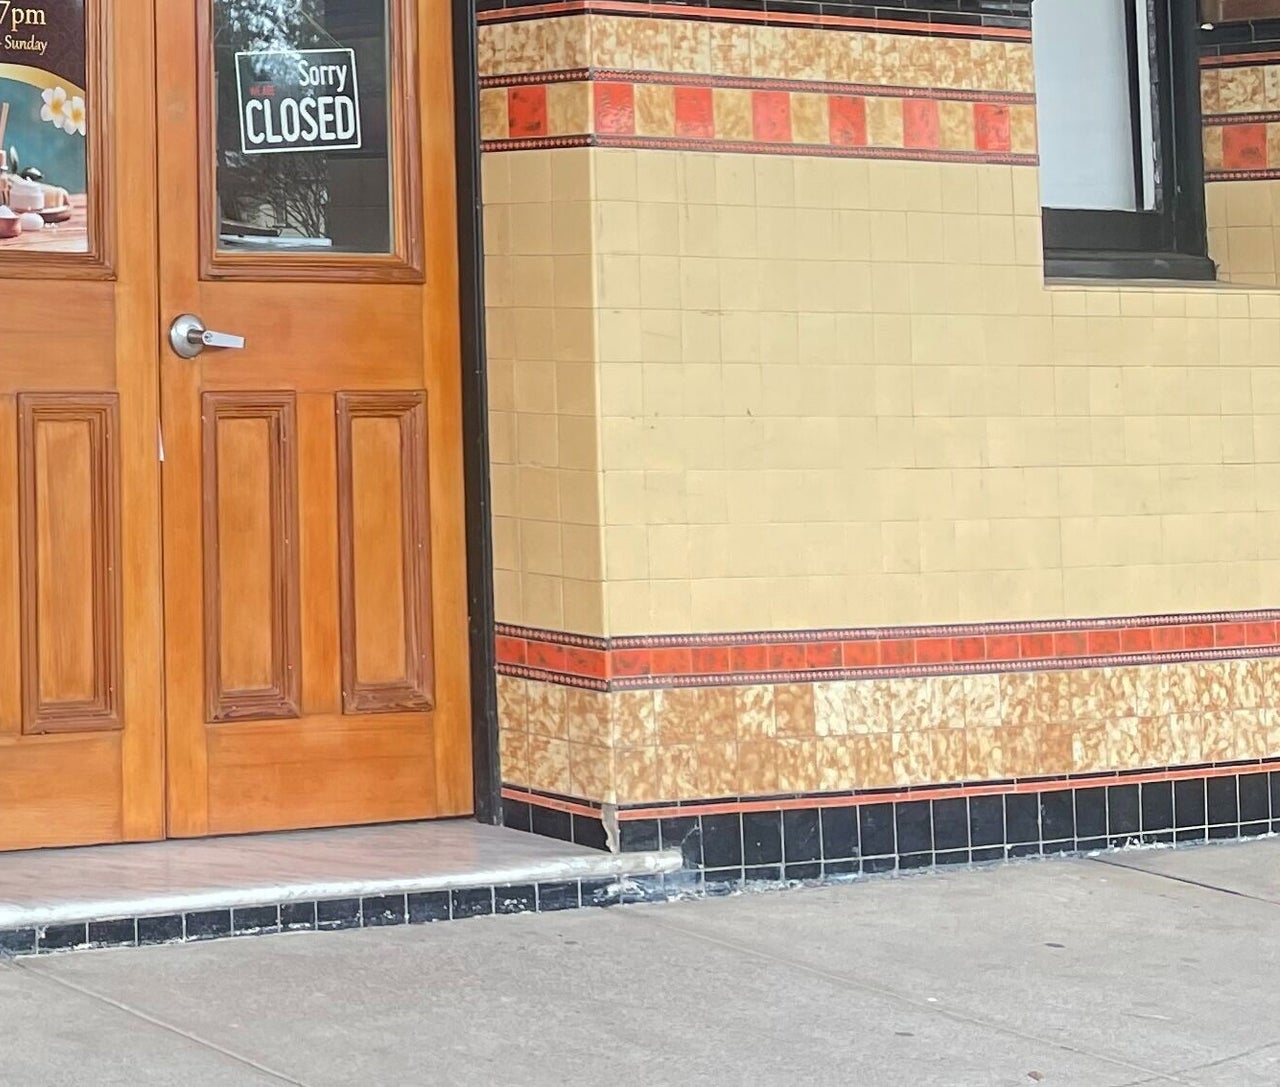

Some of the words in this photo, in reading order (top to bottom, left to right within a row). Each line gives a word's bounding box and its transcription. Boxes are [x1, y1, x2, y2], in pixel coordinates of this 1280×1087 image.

[4, 34, 48, 55] Sunday
[298, 59, 347, 92] Sorry
[245, 95, 355, 144] CLOSED
